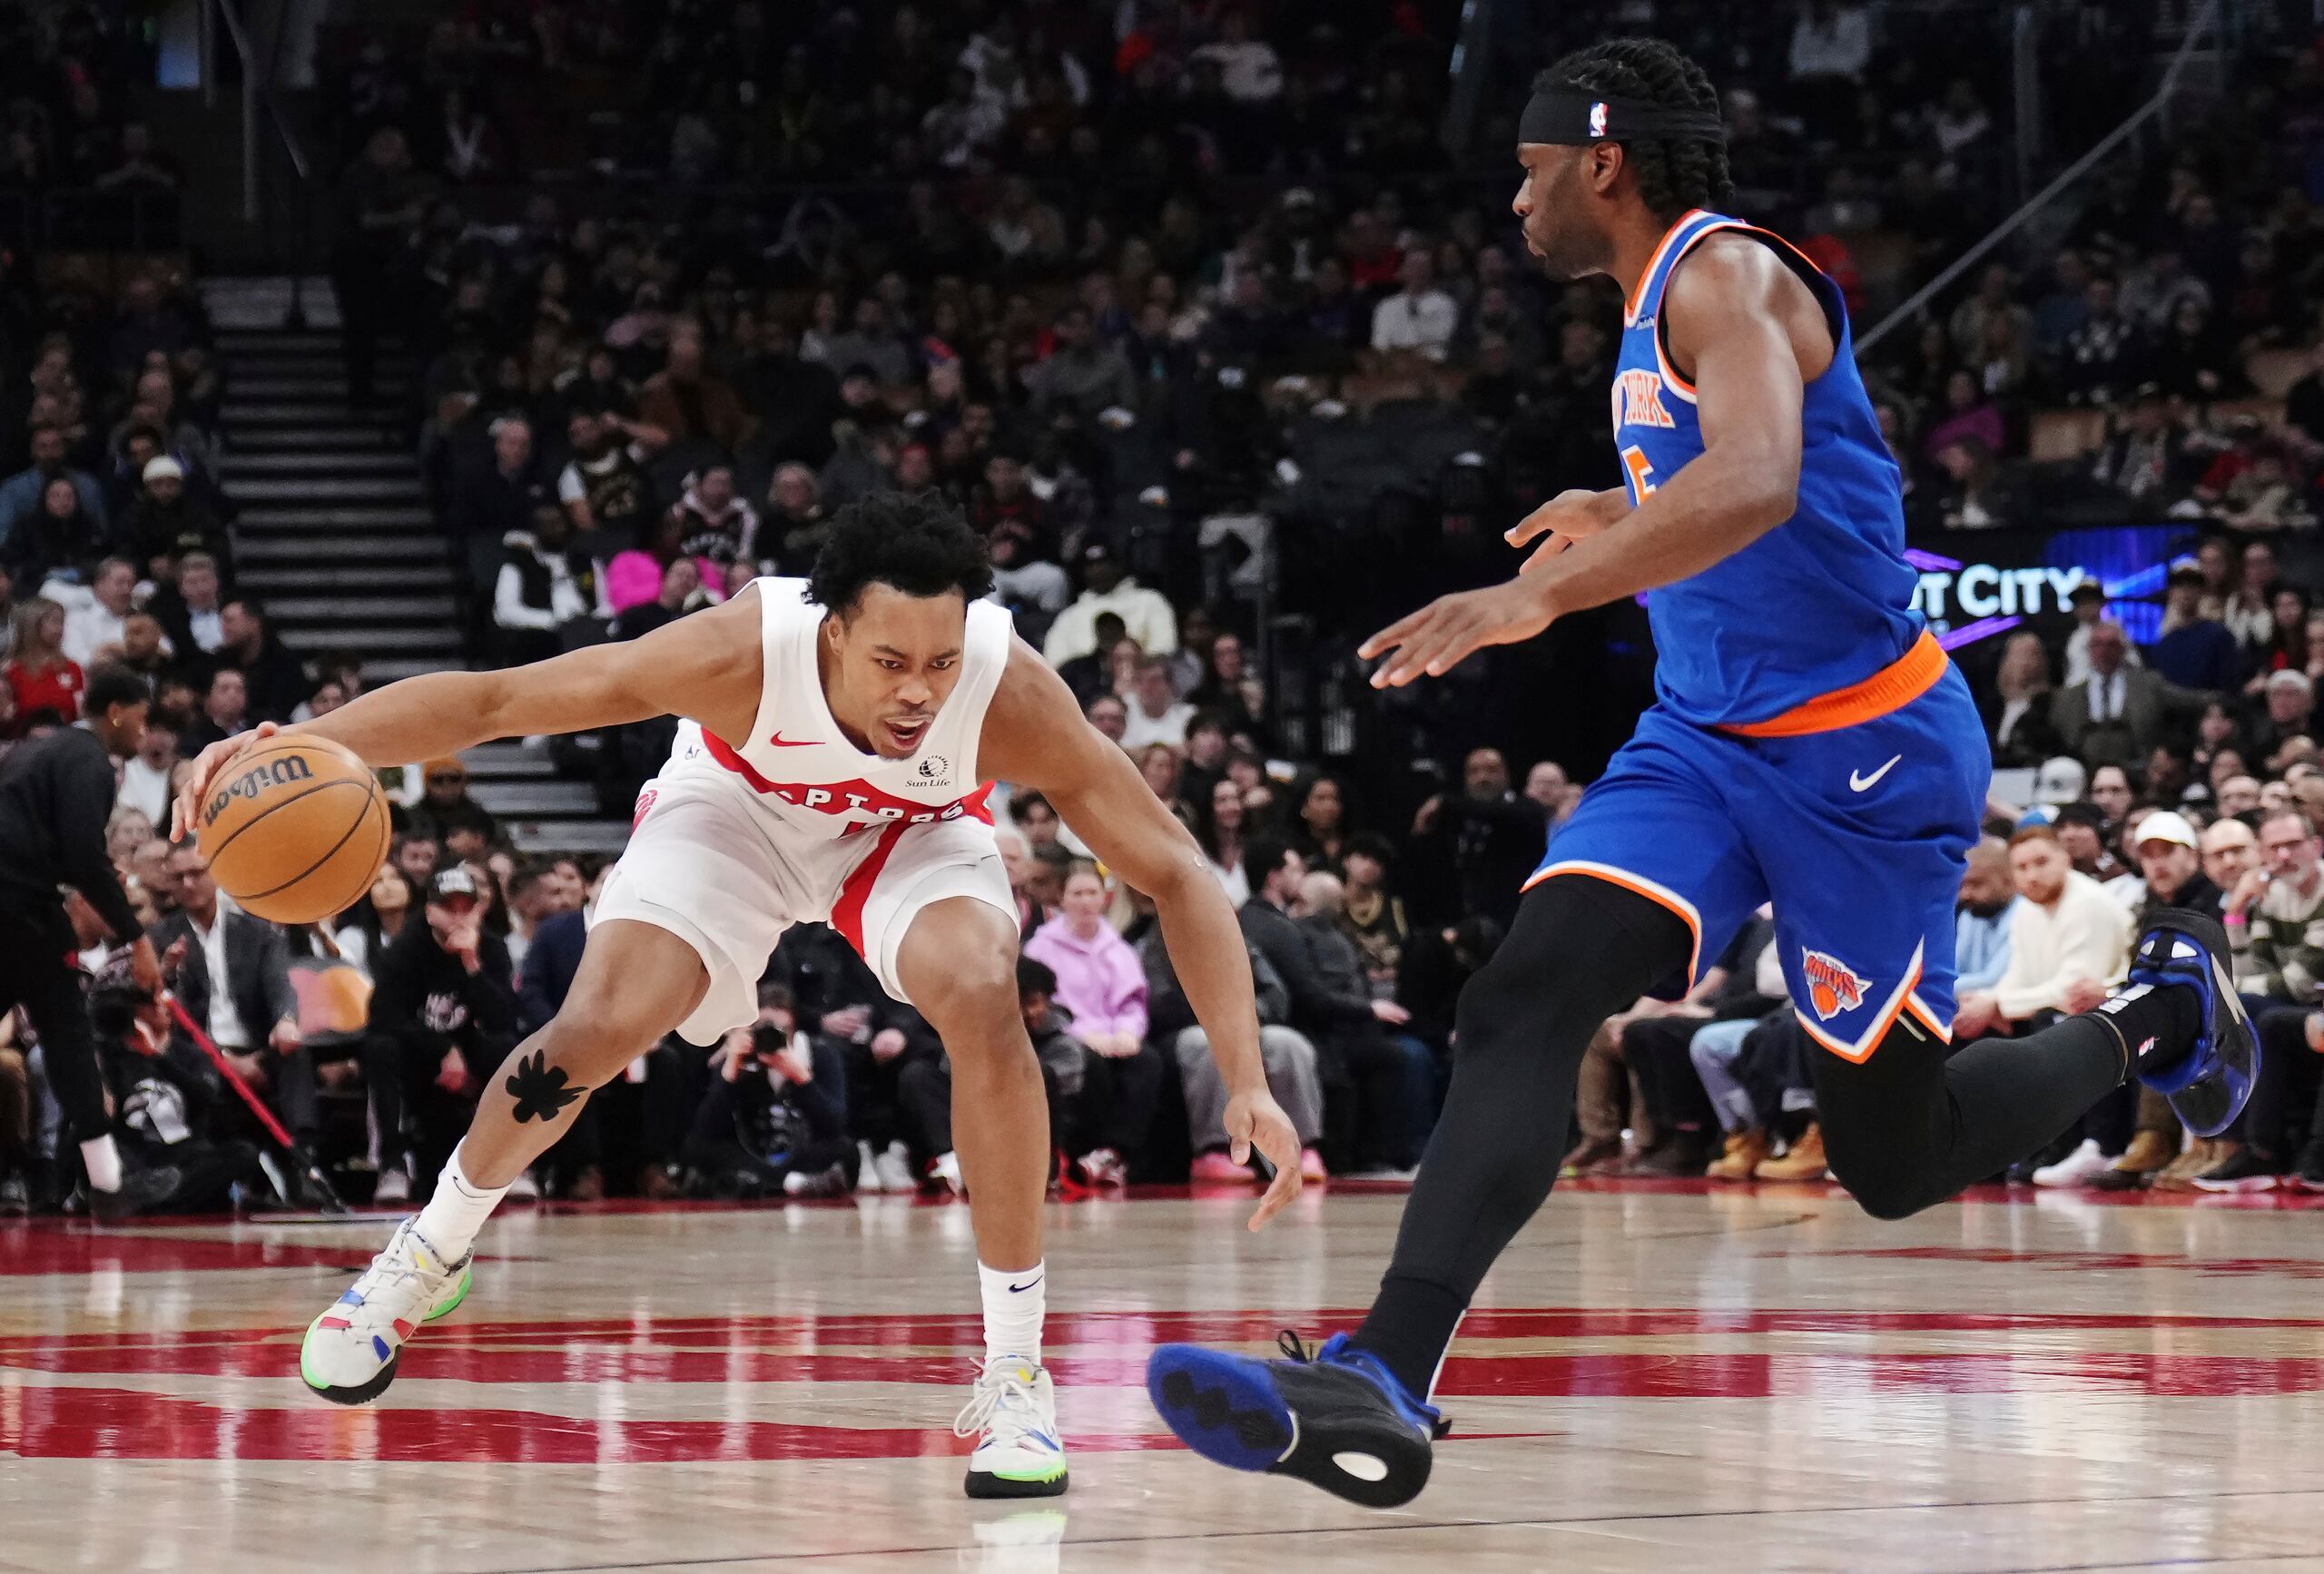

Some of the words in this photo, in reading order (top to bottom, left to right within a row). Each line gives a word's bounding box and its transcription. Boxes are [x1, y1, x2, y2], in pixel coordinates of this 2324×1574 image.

[1957, 564, 2085, 617] CITY
[203, 754, 313, 827] Wilson
[930, 779, 950, 787] Life
[778, 788, 964, 823] PTORS
